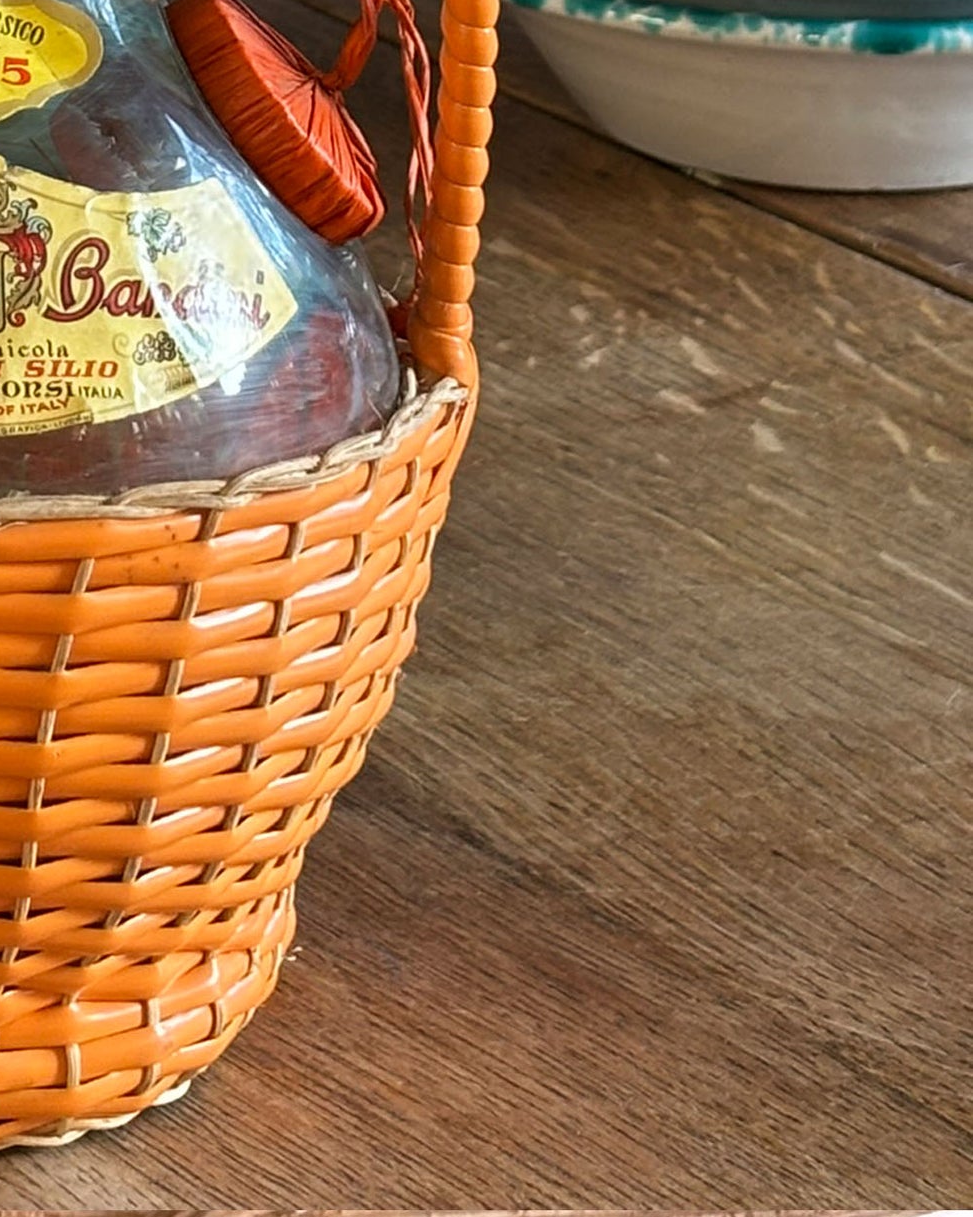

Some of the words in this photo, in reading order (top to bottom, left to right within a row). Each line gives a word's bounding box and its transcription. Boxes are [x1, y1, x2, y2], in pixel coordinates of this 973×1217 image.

[24, 359, 119, 379] SILIO
[78, 386, 124, 400] ITALIA
[20, 397, 70, 415] ITALY
